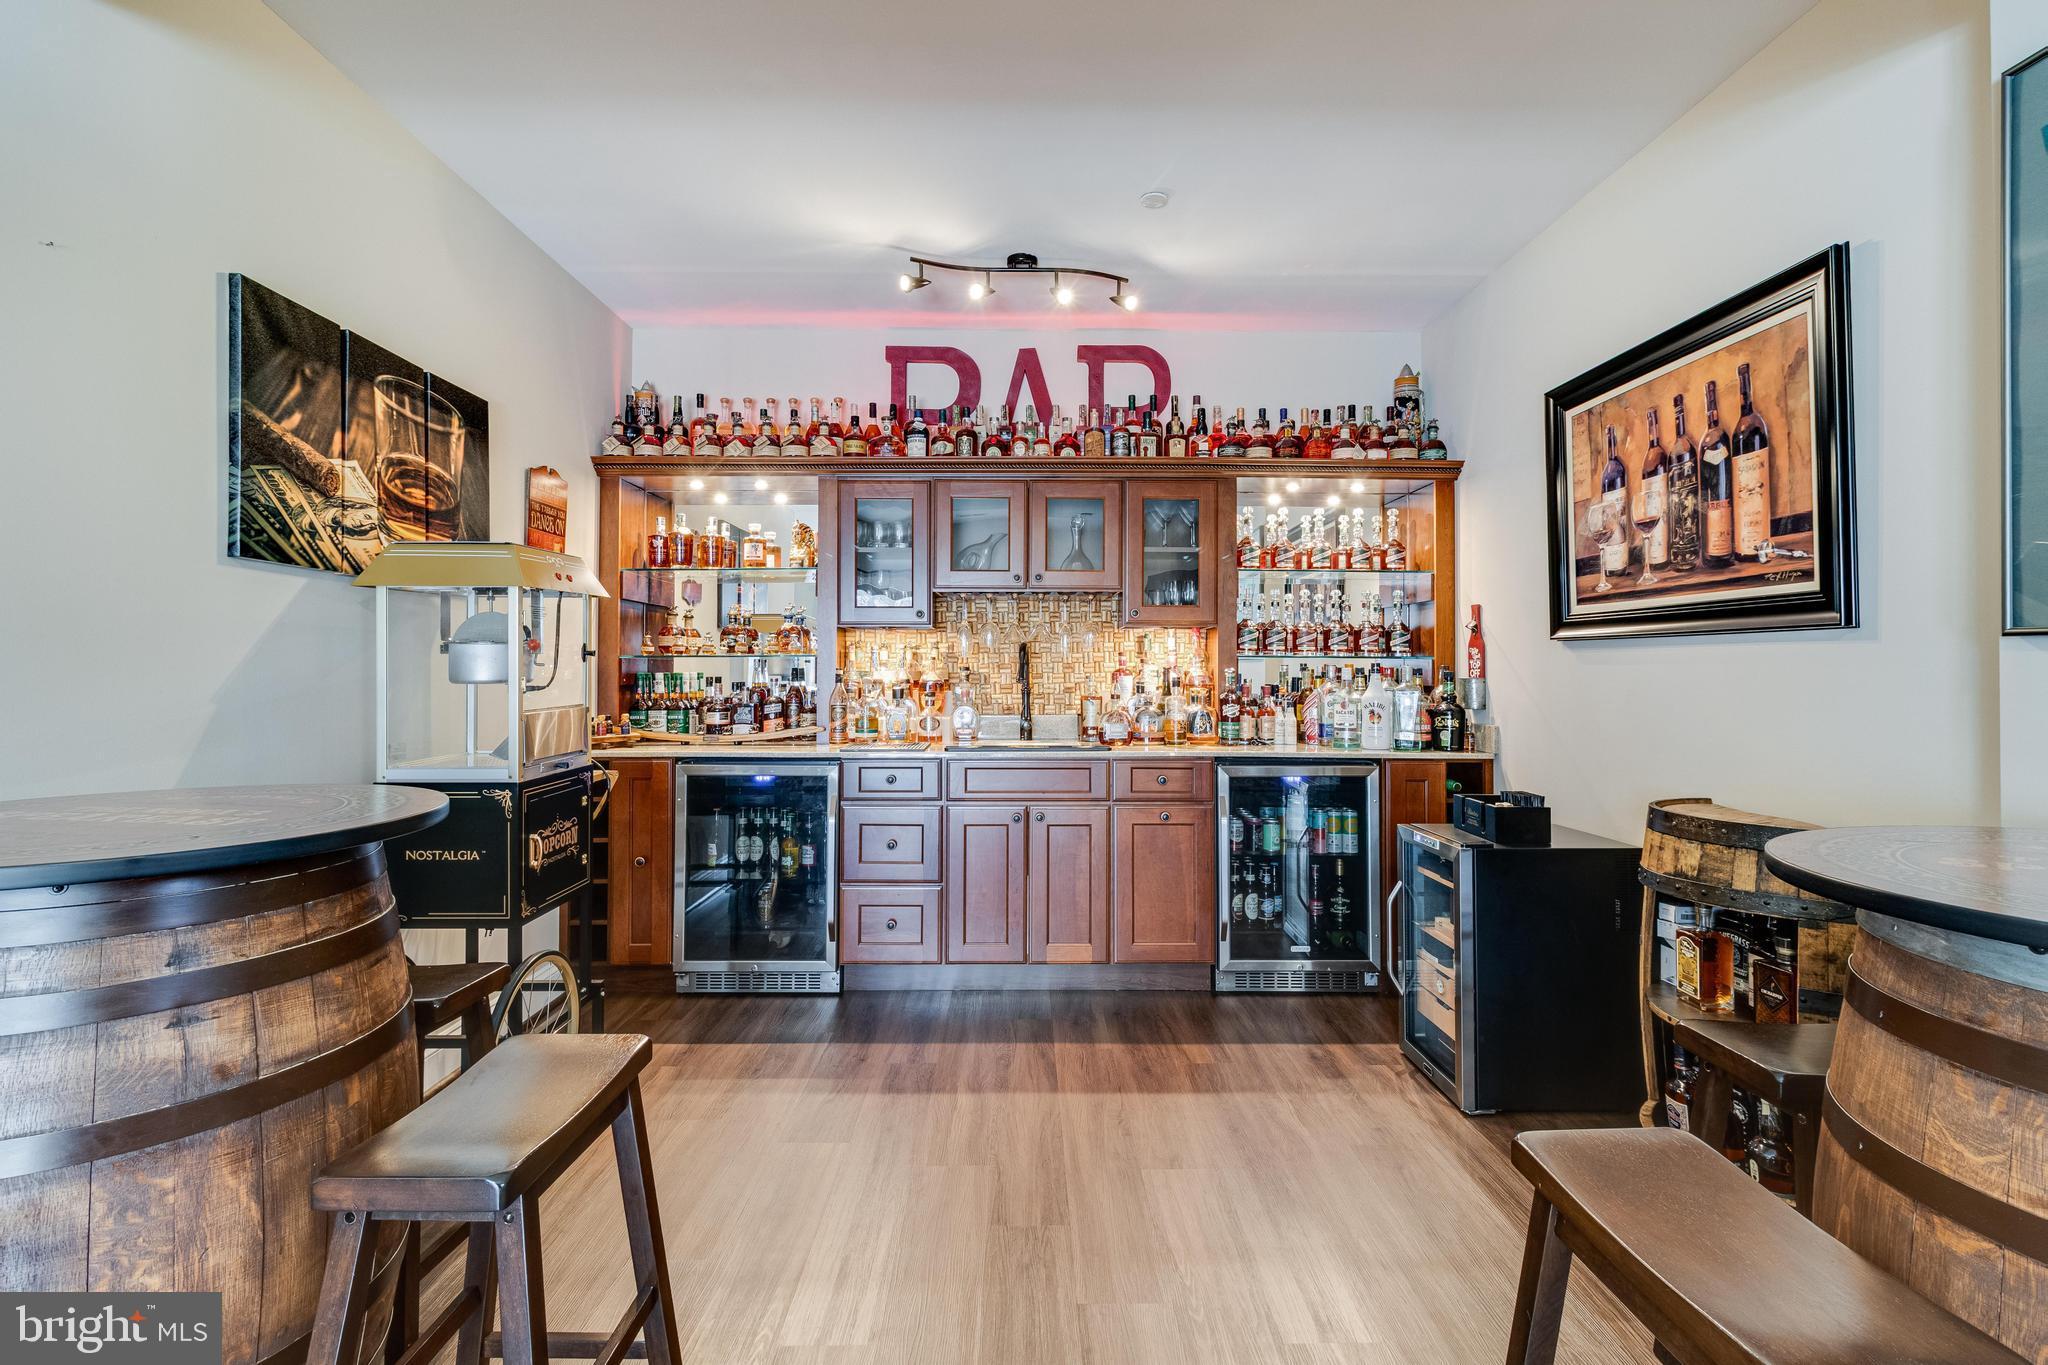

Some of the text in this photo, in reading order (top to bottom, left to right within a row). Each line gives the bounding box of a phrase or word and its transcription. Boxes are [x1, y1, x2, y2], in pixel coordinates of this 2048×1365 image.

[885, 344, 1172, 432] DAD
[531, 511, 565, 535] DANCE ON
[405, 850, 480, 861] NOSTALGIA
